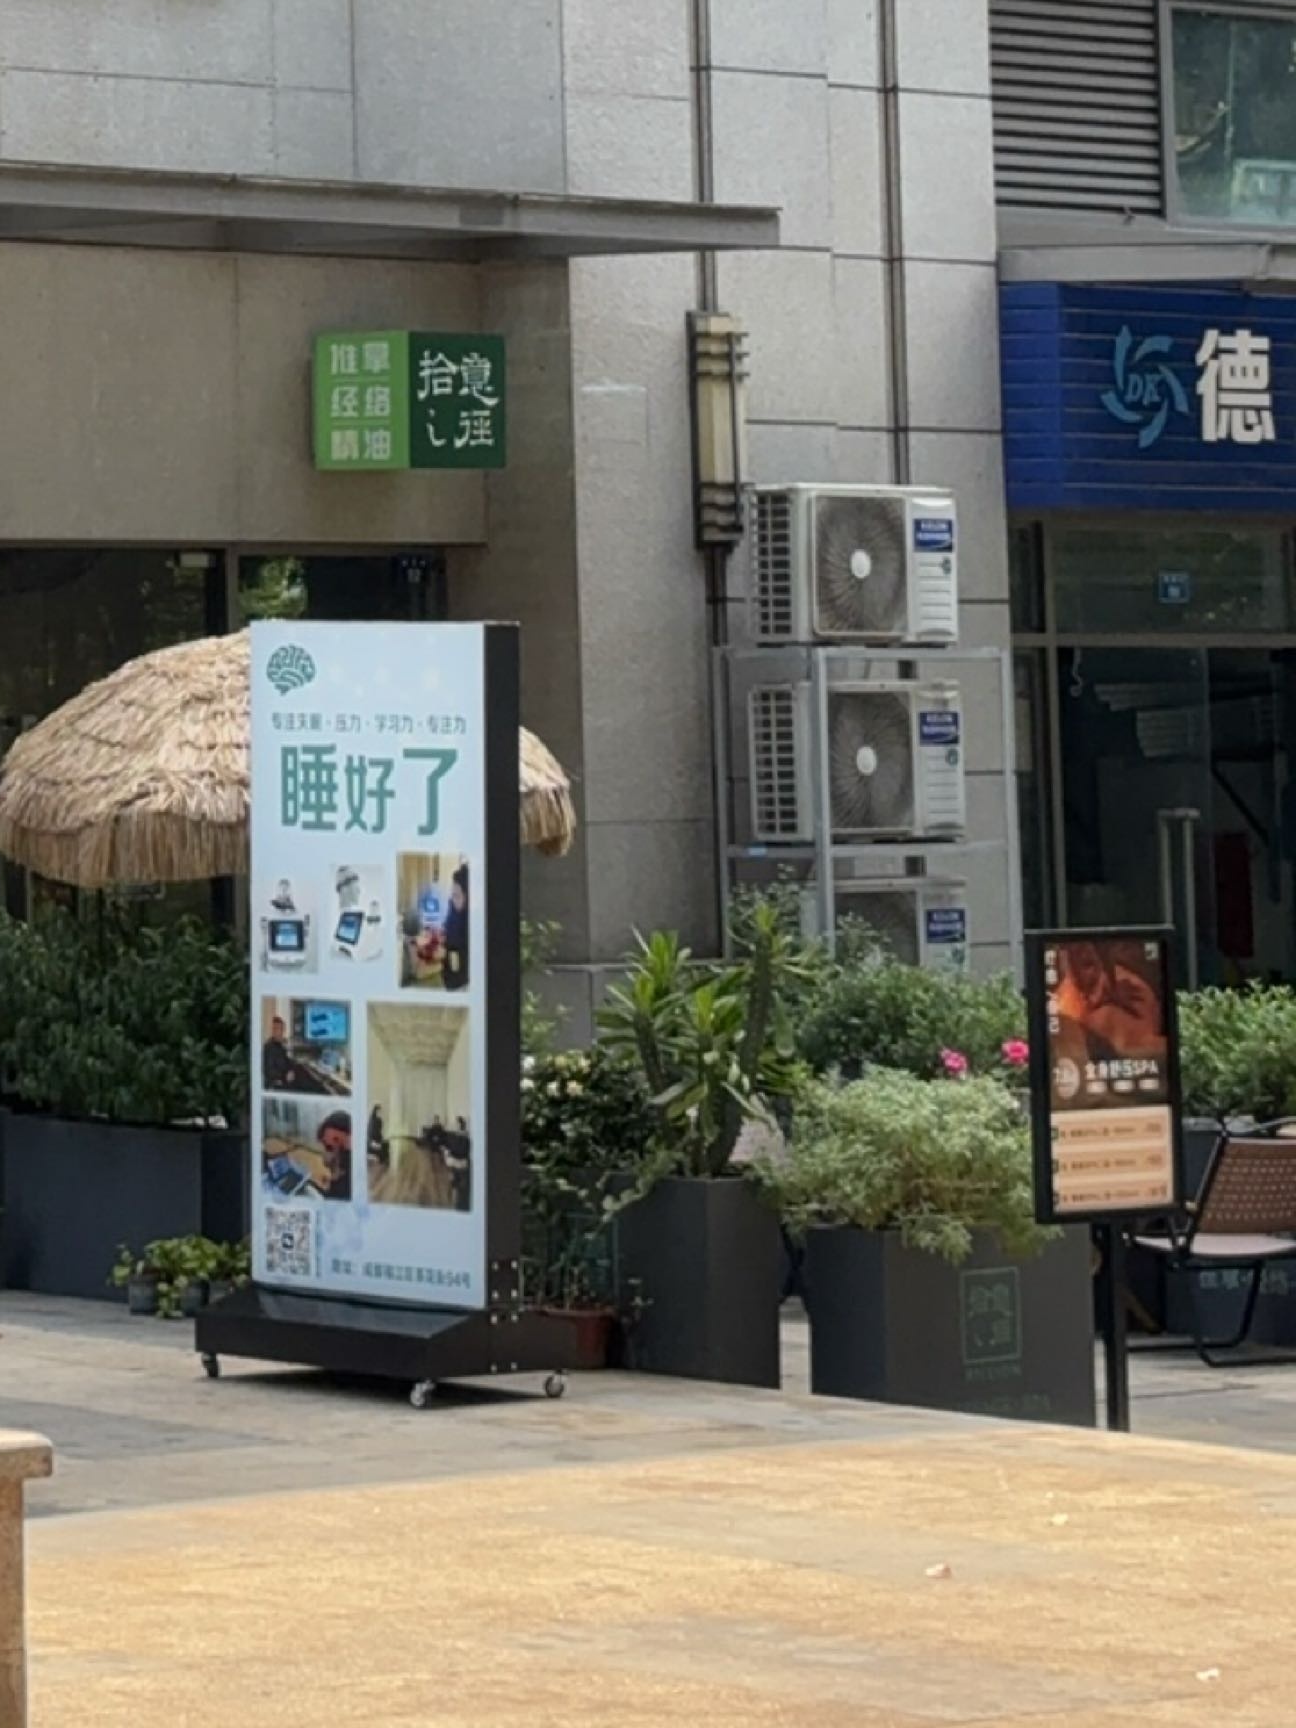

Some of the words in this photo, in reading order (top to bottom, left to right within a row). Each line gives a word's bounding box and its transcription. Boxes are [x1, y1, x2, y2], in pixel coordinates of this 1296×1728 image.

[1195, 328, 1276, 443] 德
[280, 743, 459, 836] 睡好了
